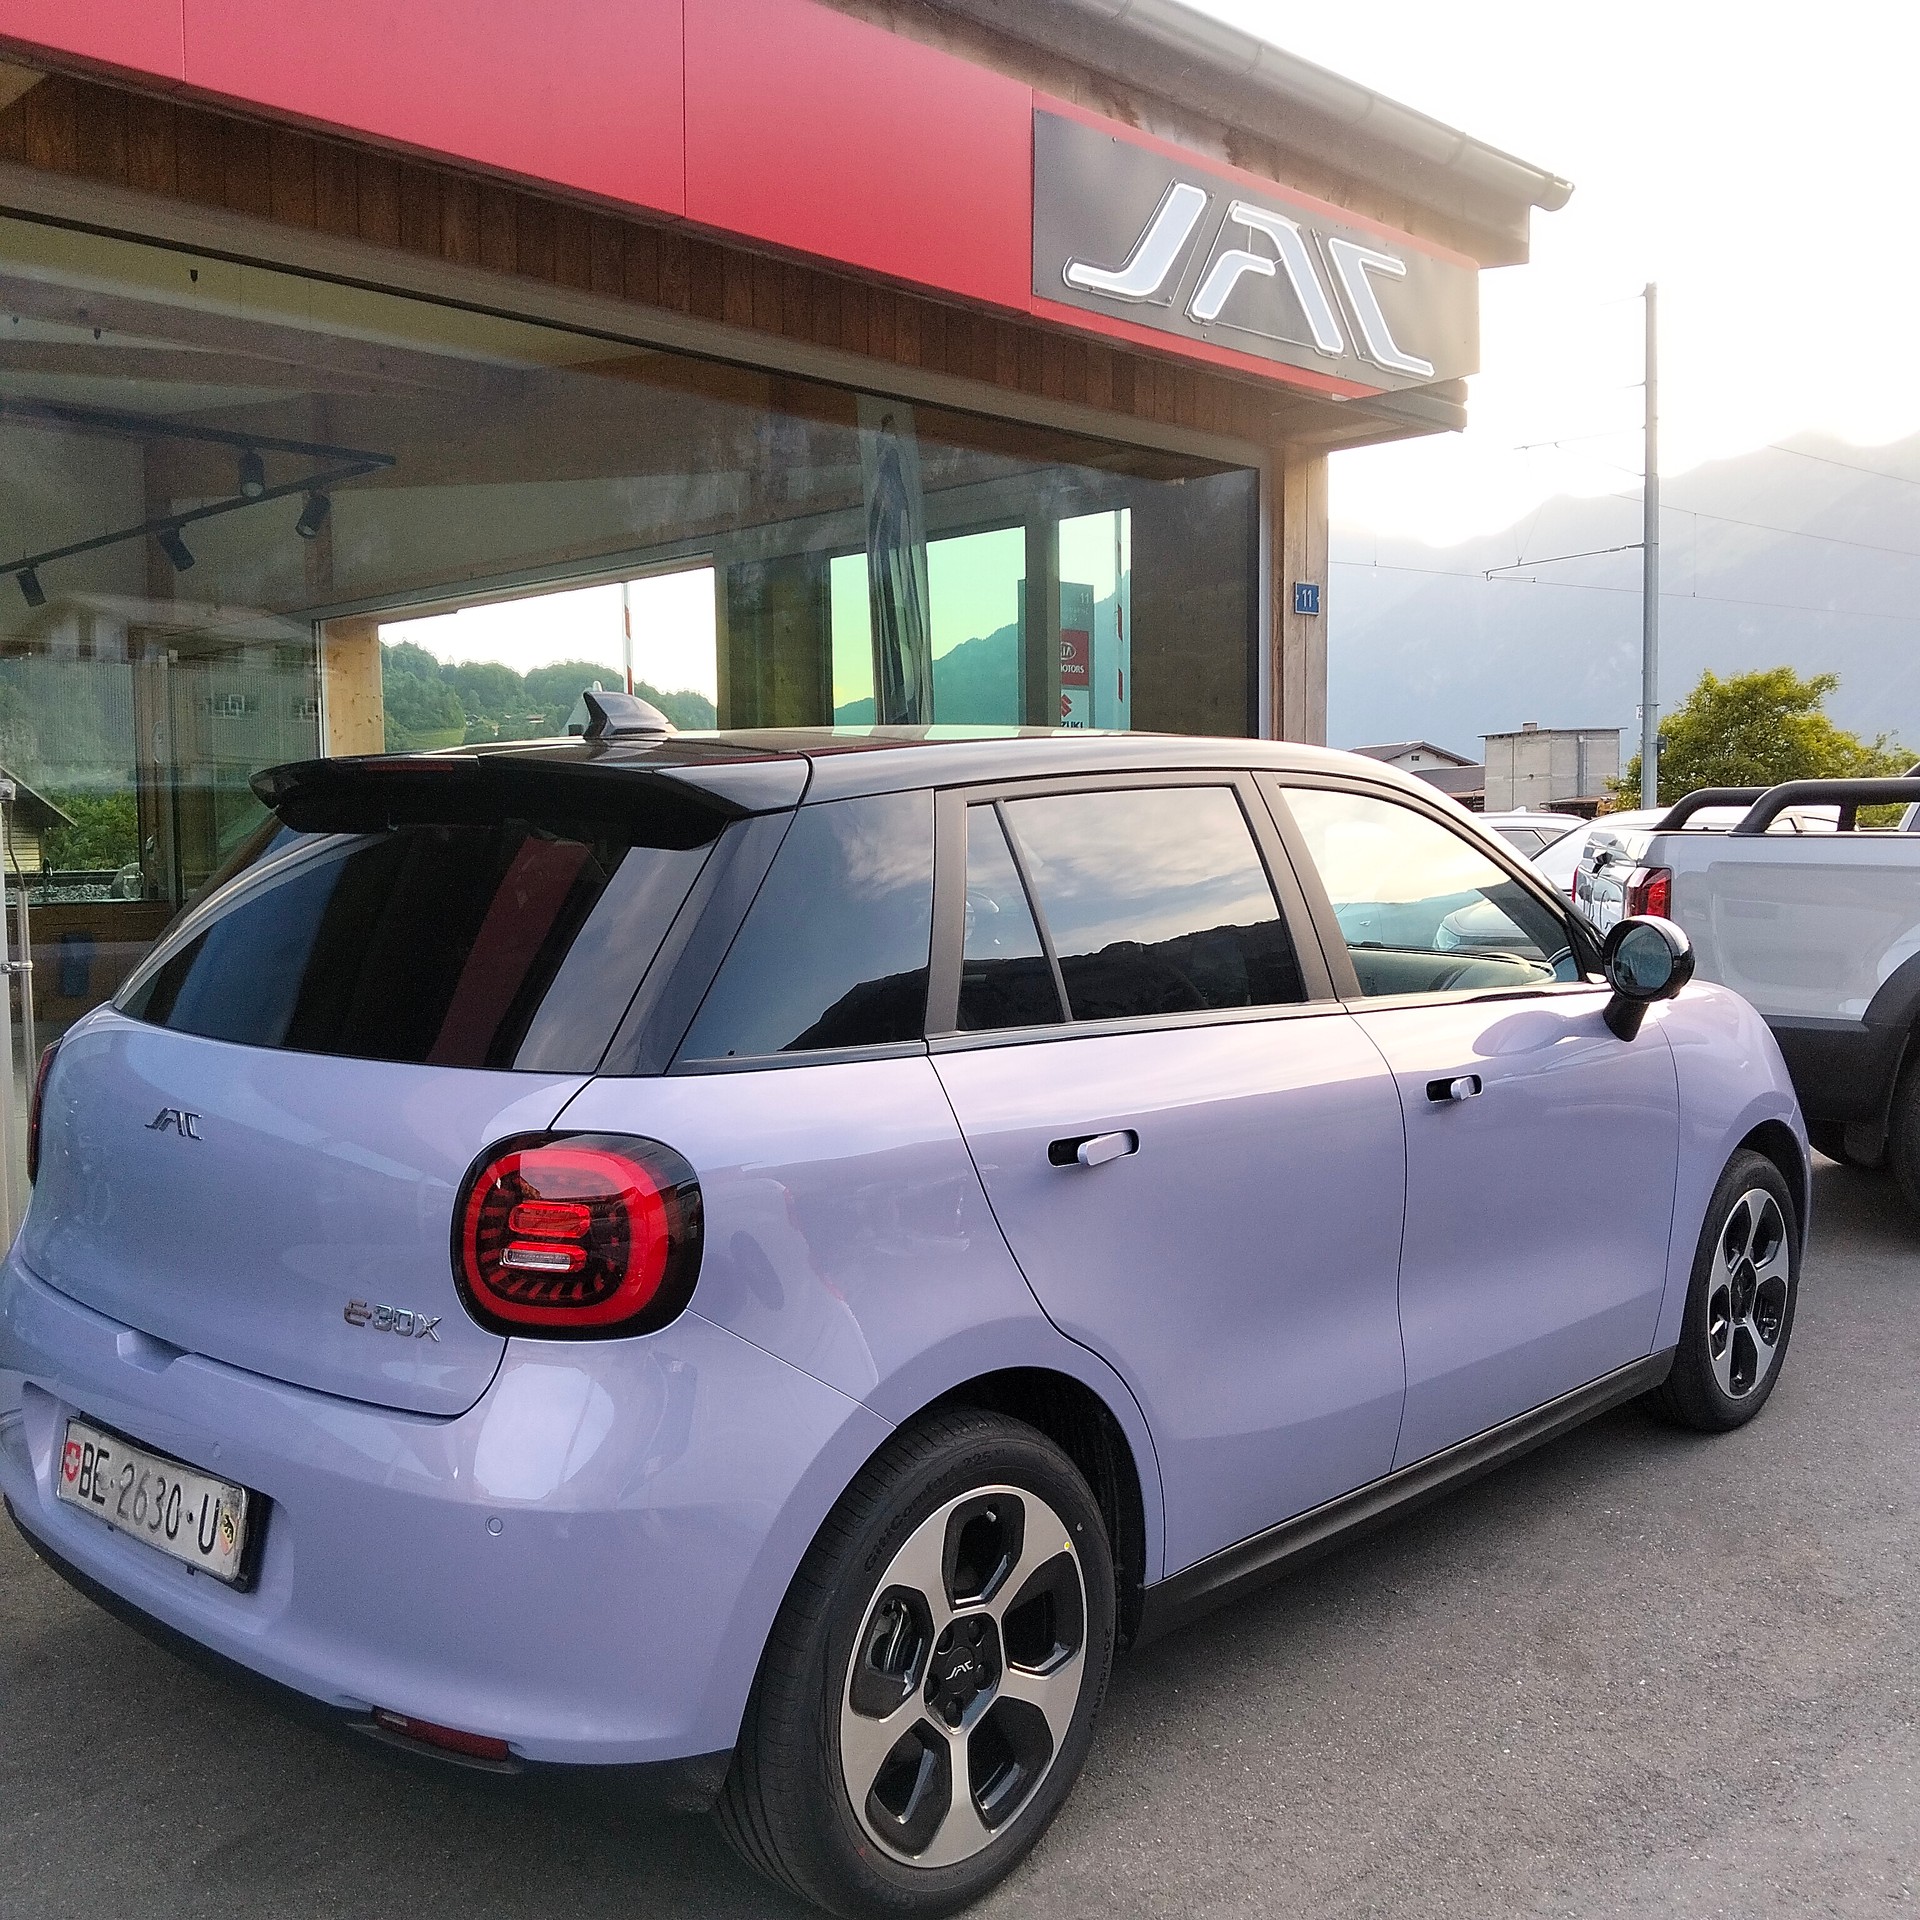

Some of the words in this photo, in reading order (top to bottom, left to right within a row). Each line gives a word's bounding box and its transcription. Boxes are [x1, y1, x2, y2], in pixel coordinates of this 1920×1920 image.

[1067, 182, 1436, 378] JAC
[1302, 589, 1312, 608] 11
[144, 1106, 204, 1141] JAC
[945, 1660, 974, 1680] JAC
